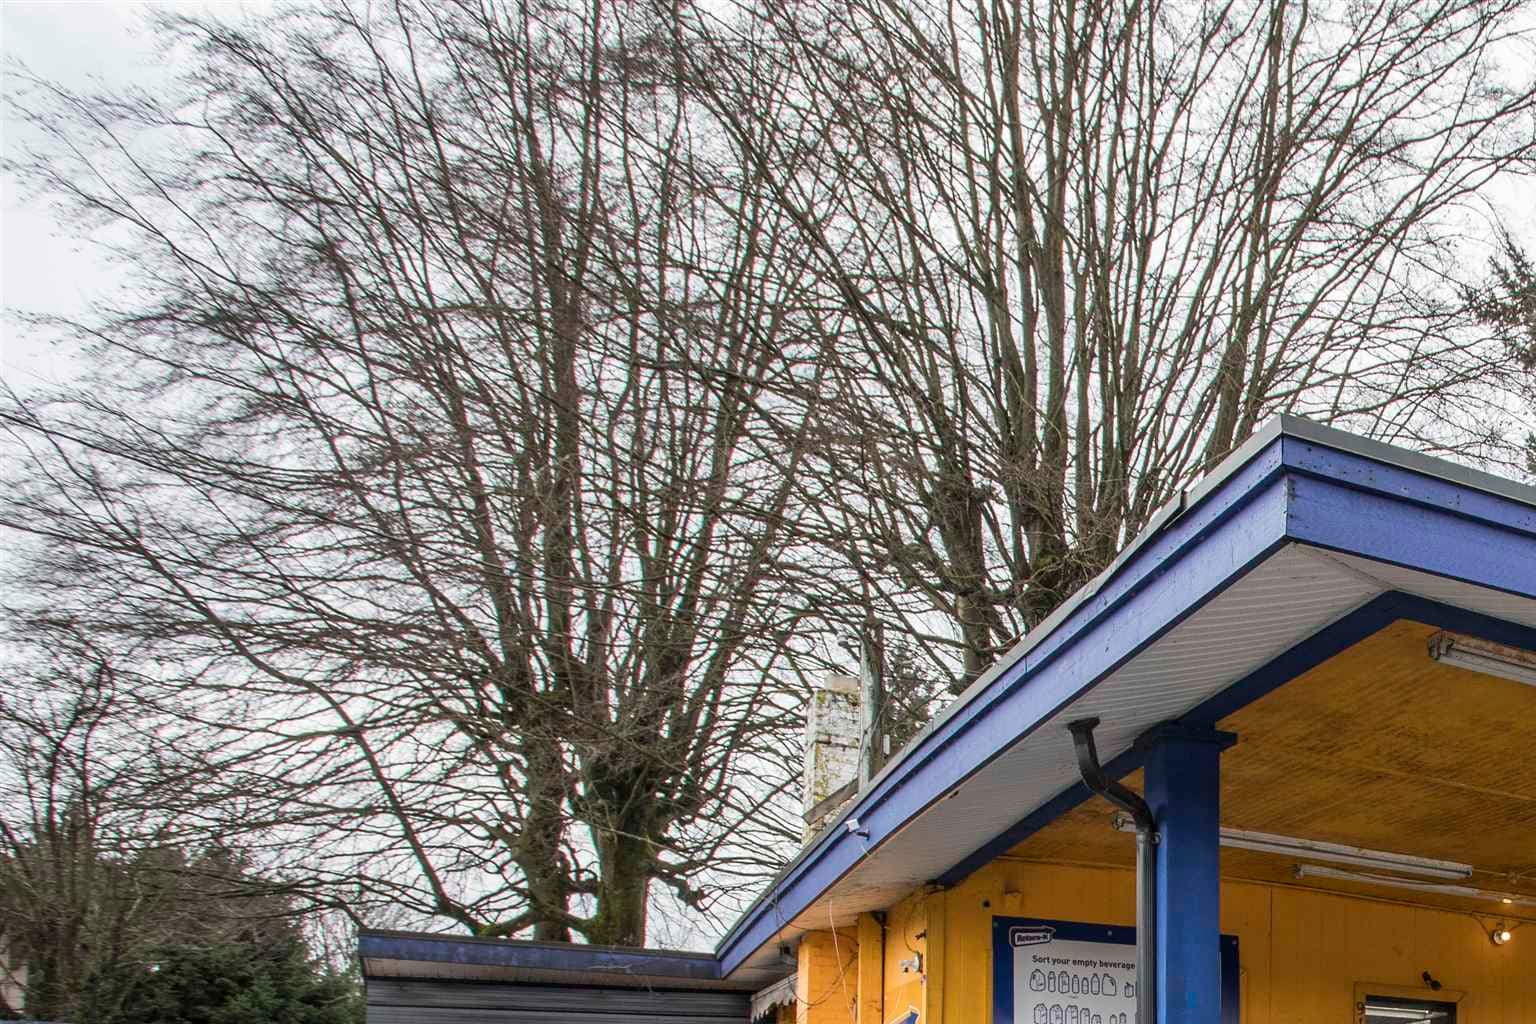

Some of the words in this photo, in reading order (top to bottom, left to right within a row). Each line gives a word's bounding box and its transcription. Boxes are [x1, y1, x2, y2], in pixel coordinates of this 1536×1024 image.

[1032, 955, 1050, 963] Sort
[1052, 957, 1071, 966] your
[1073, 959, 1097, 969] empty
[1099, 960, 1136, 970] beverage
